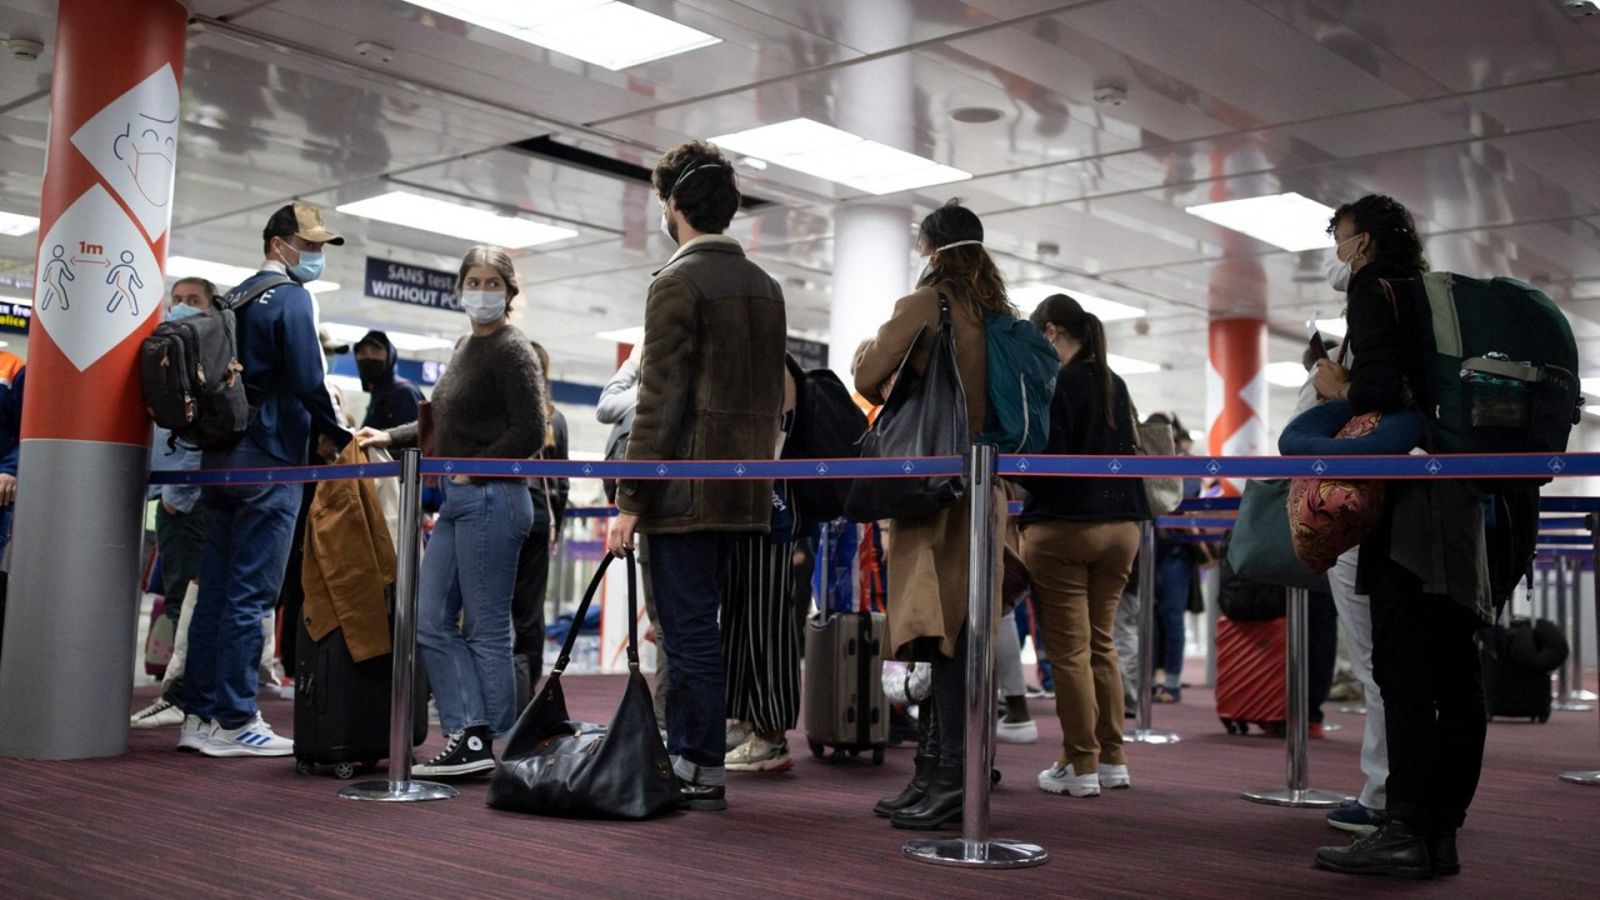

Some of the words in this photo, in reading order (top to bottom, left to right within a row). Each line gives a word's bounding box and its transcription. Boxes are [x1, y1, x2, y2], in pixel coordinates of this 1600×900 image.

[79, 240, 104, 255] 1m
[388, 264, 424, 284] SANS
[372, 281, 438, 304] WITHOUT
